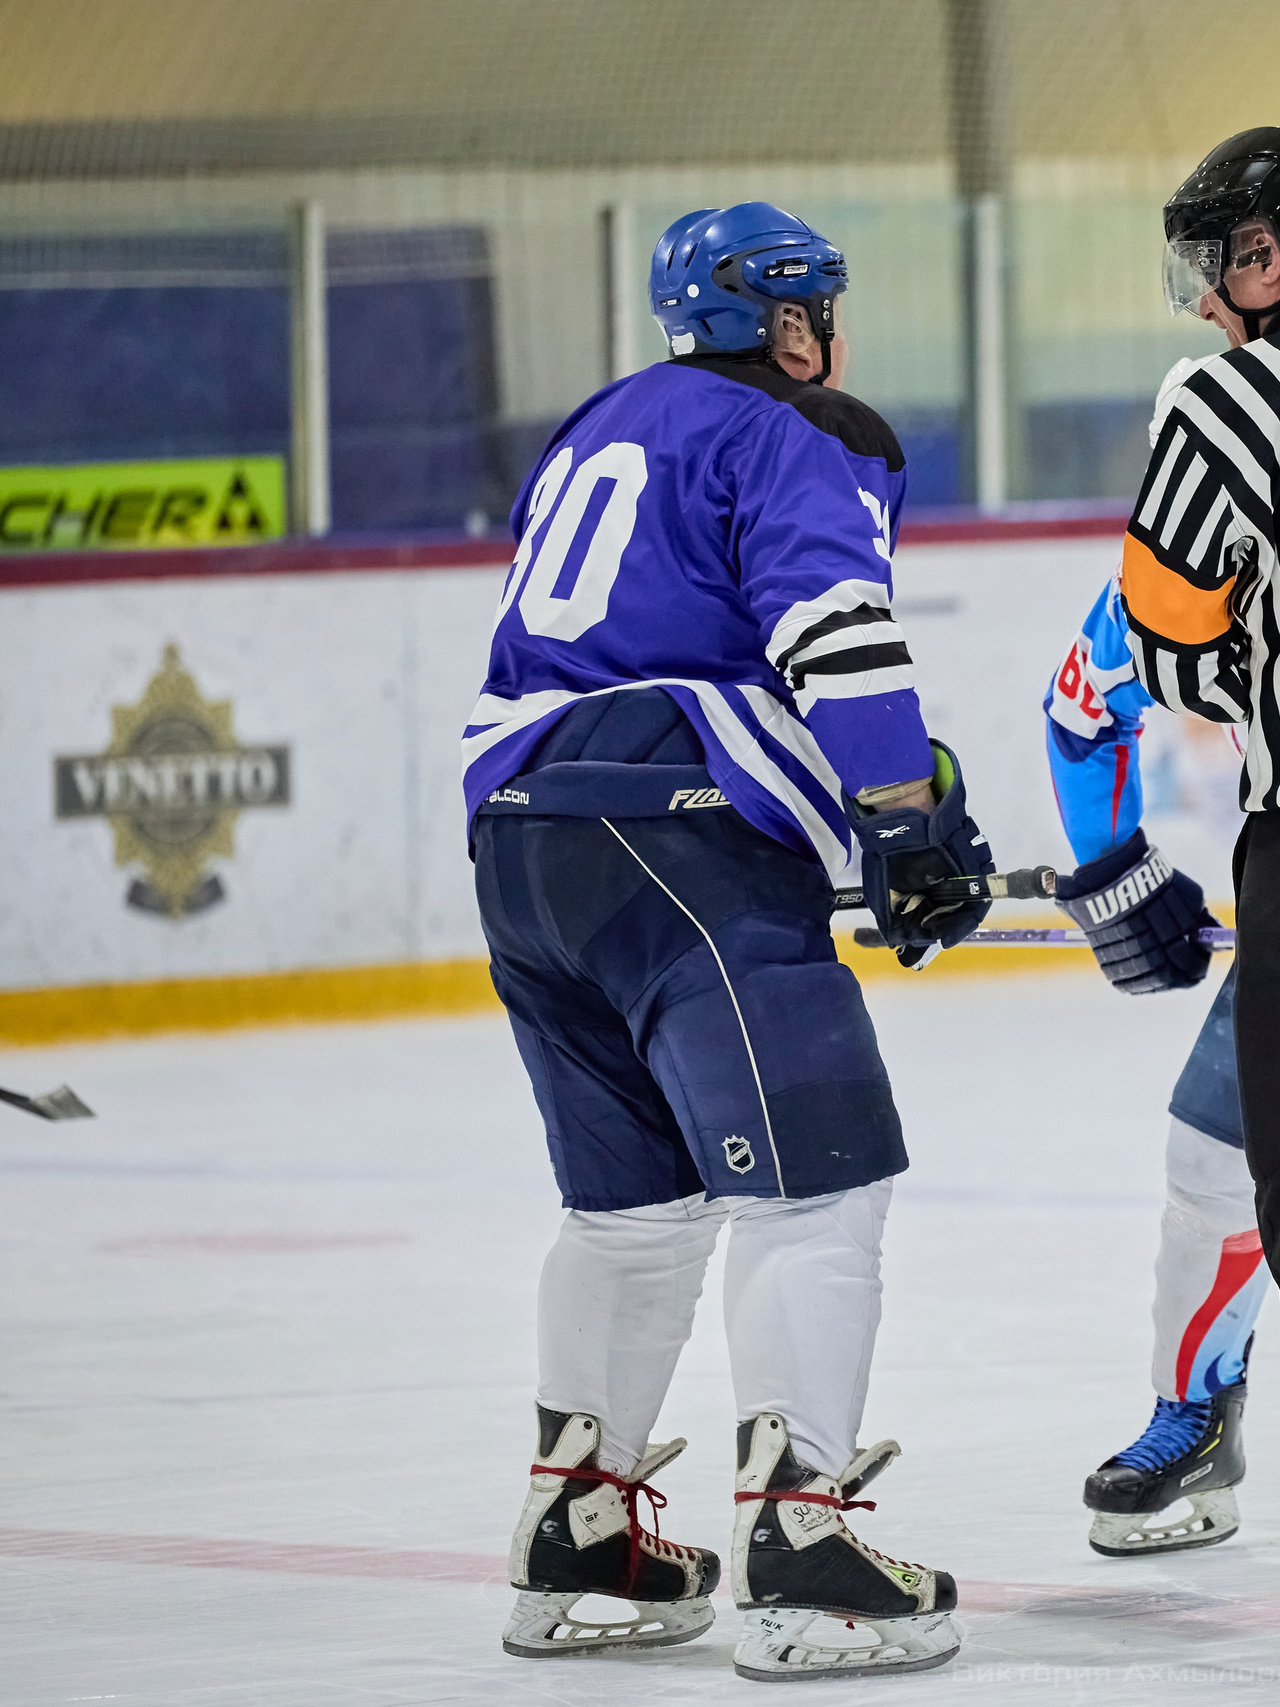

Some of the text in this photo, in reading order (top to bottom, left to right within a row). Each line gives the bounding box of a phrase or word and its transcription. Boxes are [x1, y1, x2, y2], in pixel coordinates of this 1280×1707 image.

[490, 441, 648, 643] 30
[72, 752, 277, 810] VENETTO
[484, 788, 530, 805] ALCON
